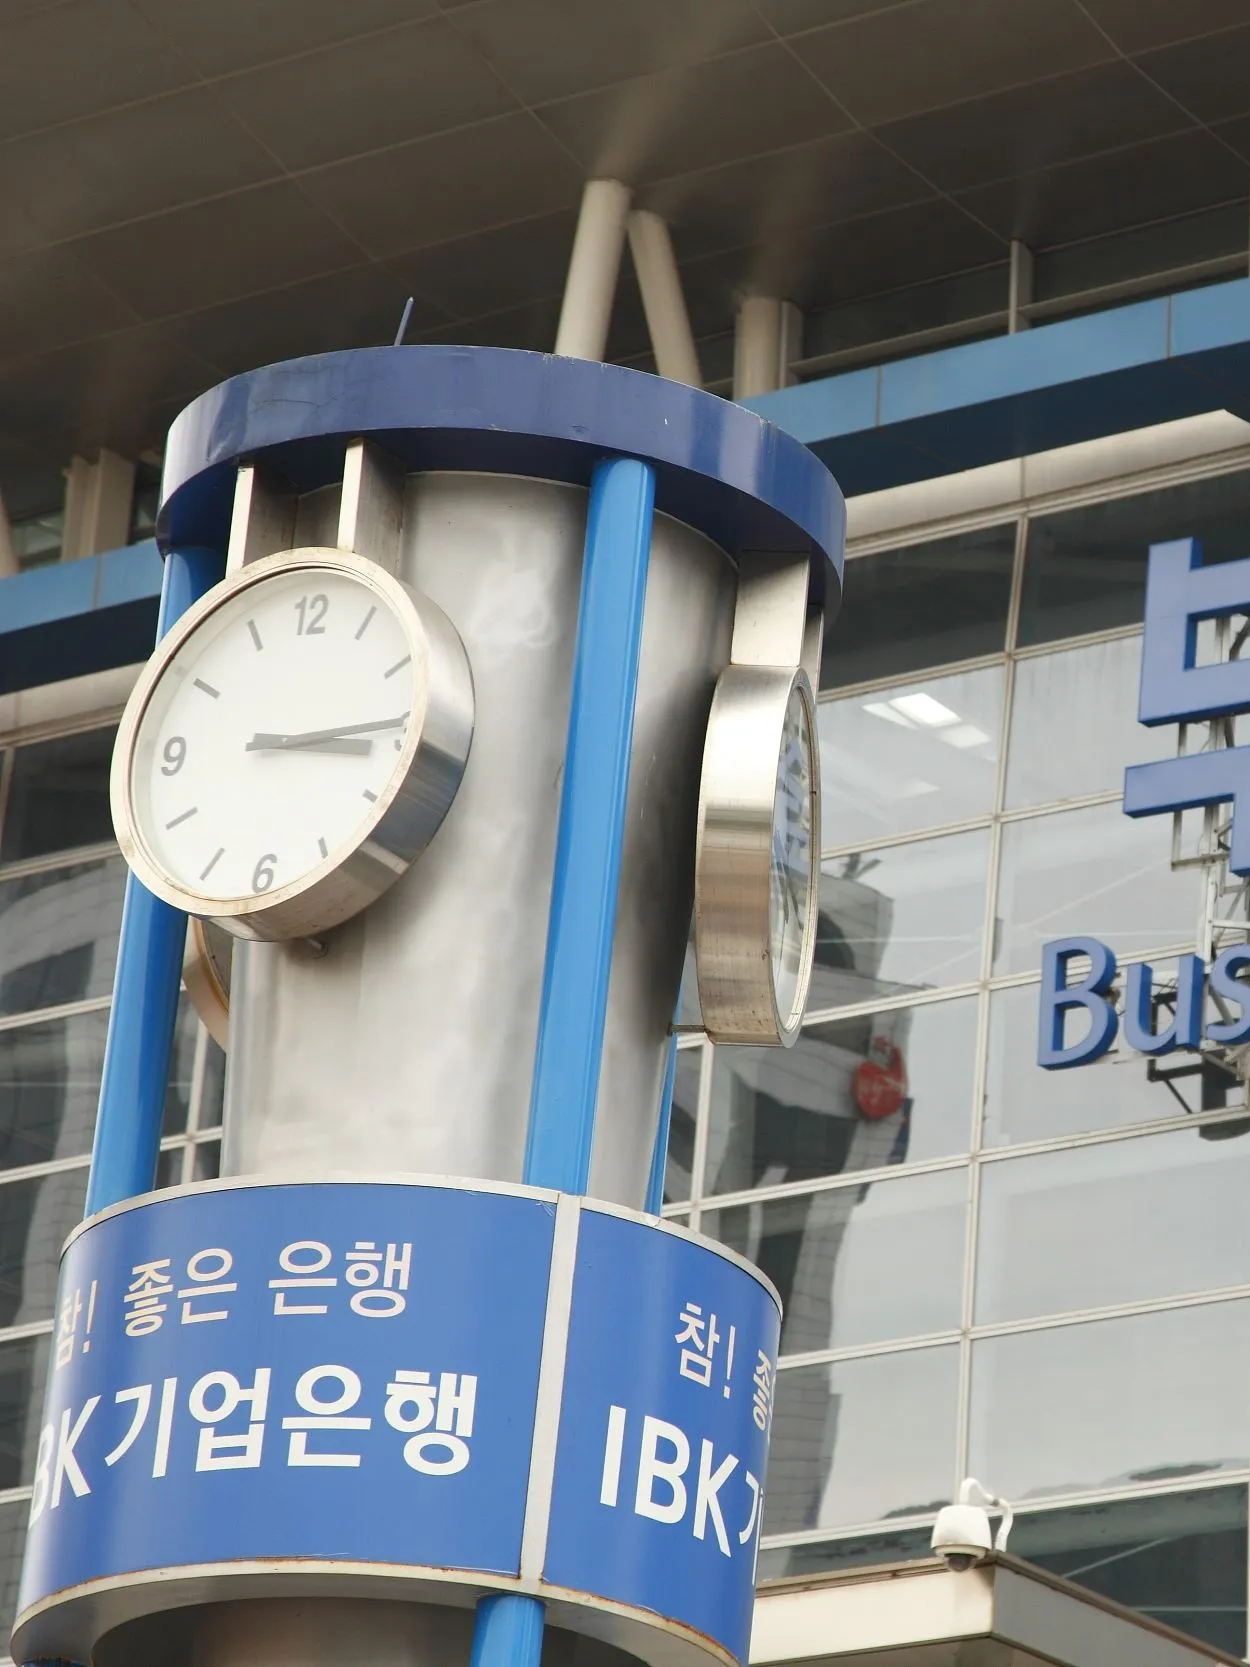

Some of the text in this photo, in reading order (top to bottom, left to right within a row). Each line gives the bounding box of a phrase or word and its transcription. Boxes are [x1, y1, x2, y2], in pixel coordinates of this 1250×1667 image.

[293, 593, 330, 637] 12
[160, 735, 188, 777] 9
[250, 853, 278, 895] 6
[123, 1247, 238, 1338] 좋은
[267, 1240, 413, 1319] 은행
[674, 1302, 777, 1446] 참! 좋
